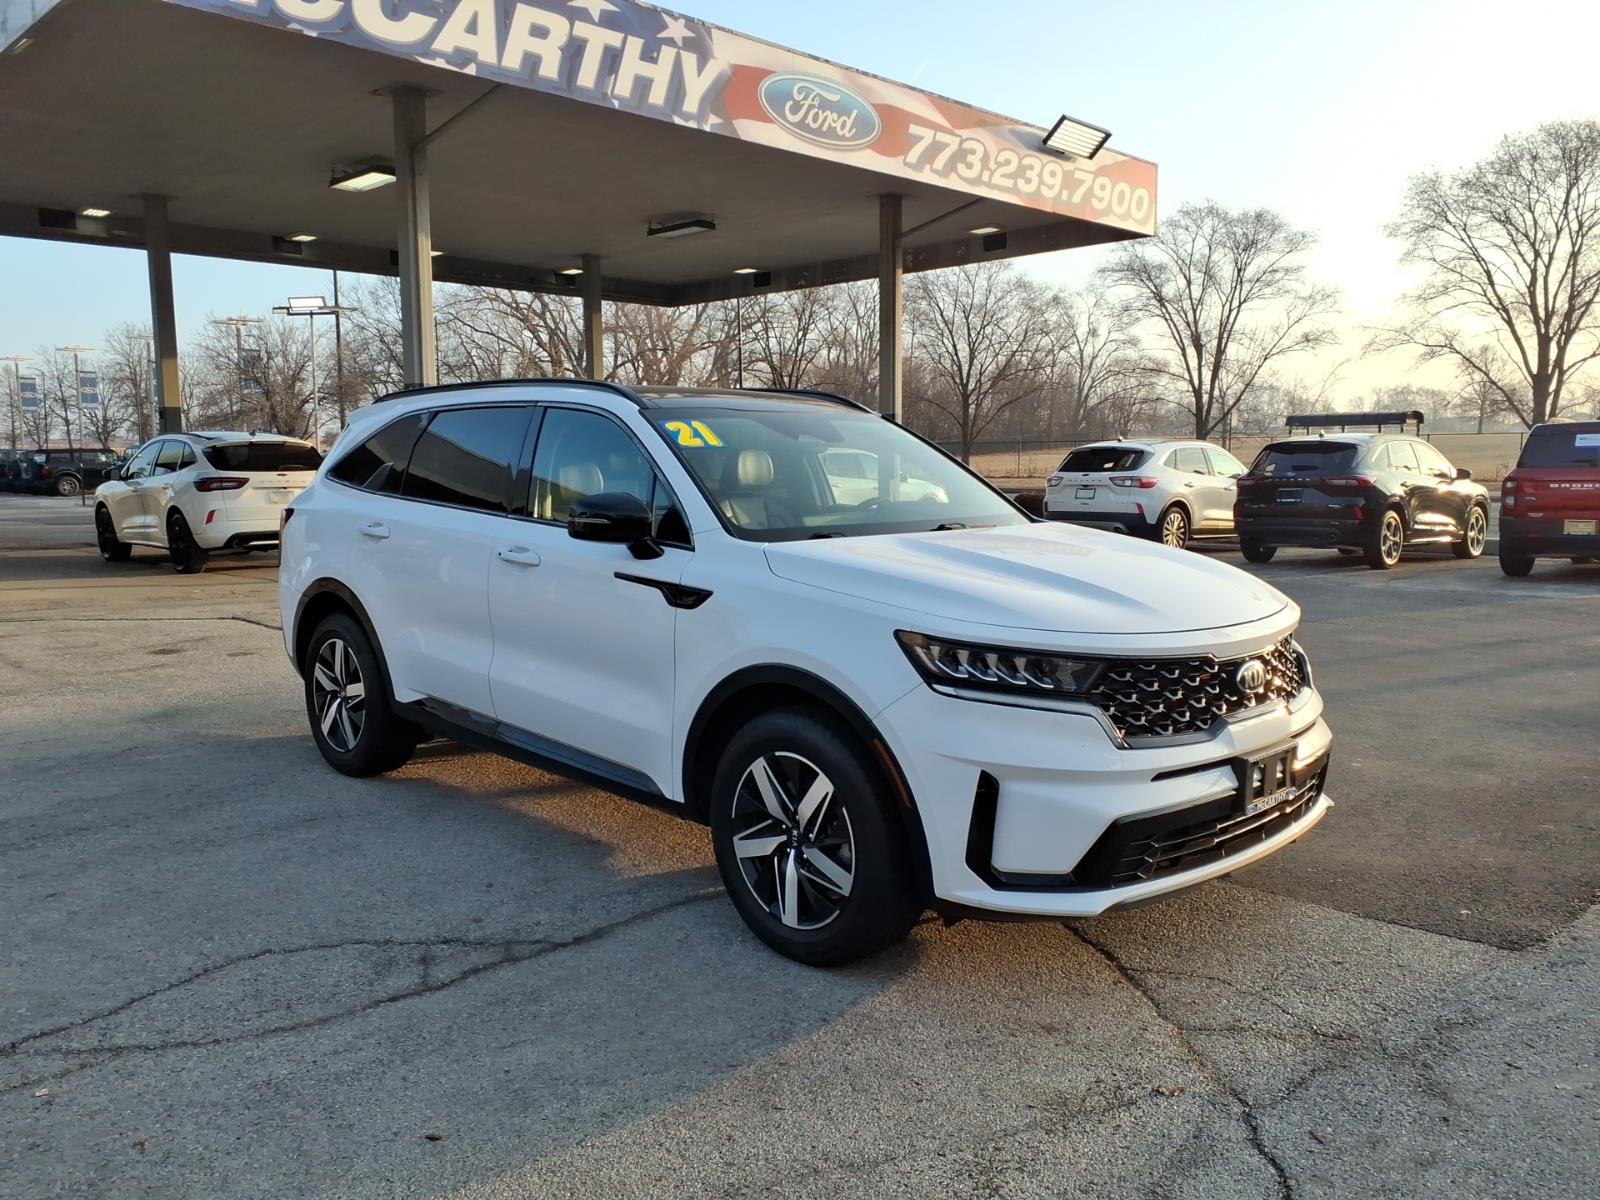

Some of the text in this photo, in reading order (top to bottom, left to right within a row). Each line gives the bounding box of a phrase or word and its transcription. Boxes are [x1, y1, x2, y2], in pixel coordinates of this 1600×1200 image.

[228, 0, 730, 115] CARTHY
[785, 82, 859, 138] Ford
[904, 124, 1149, 220] 773.239.7900
[665, 420, 723, 447] 21
[1243, 668, 1264, 688] KIA
